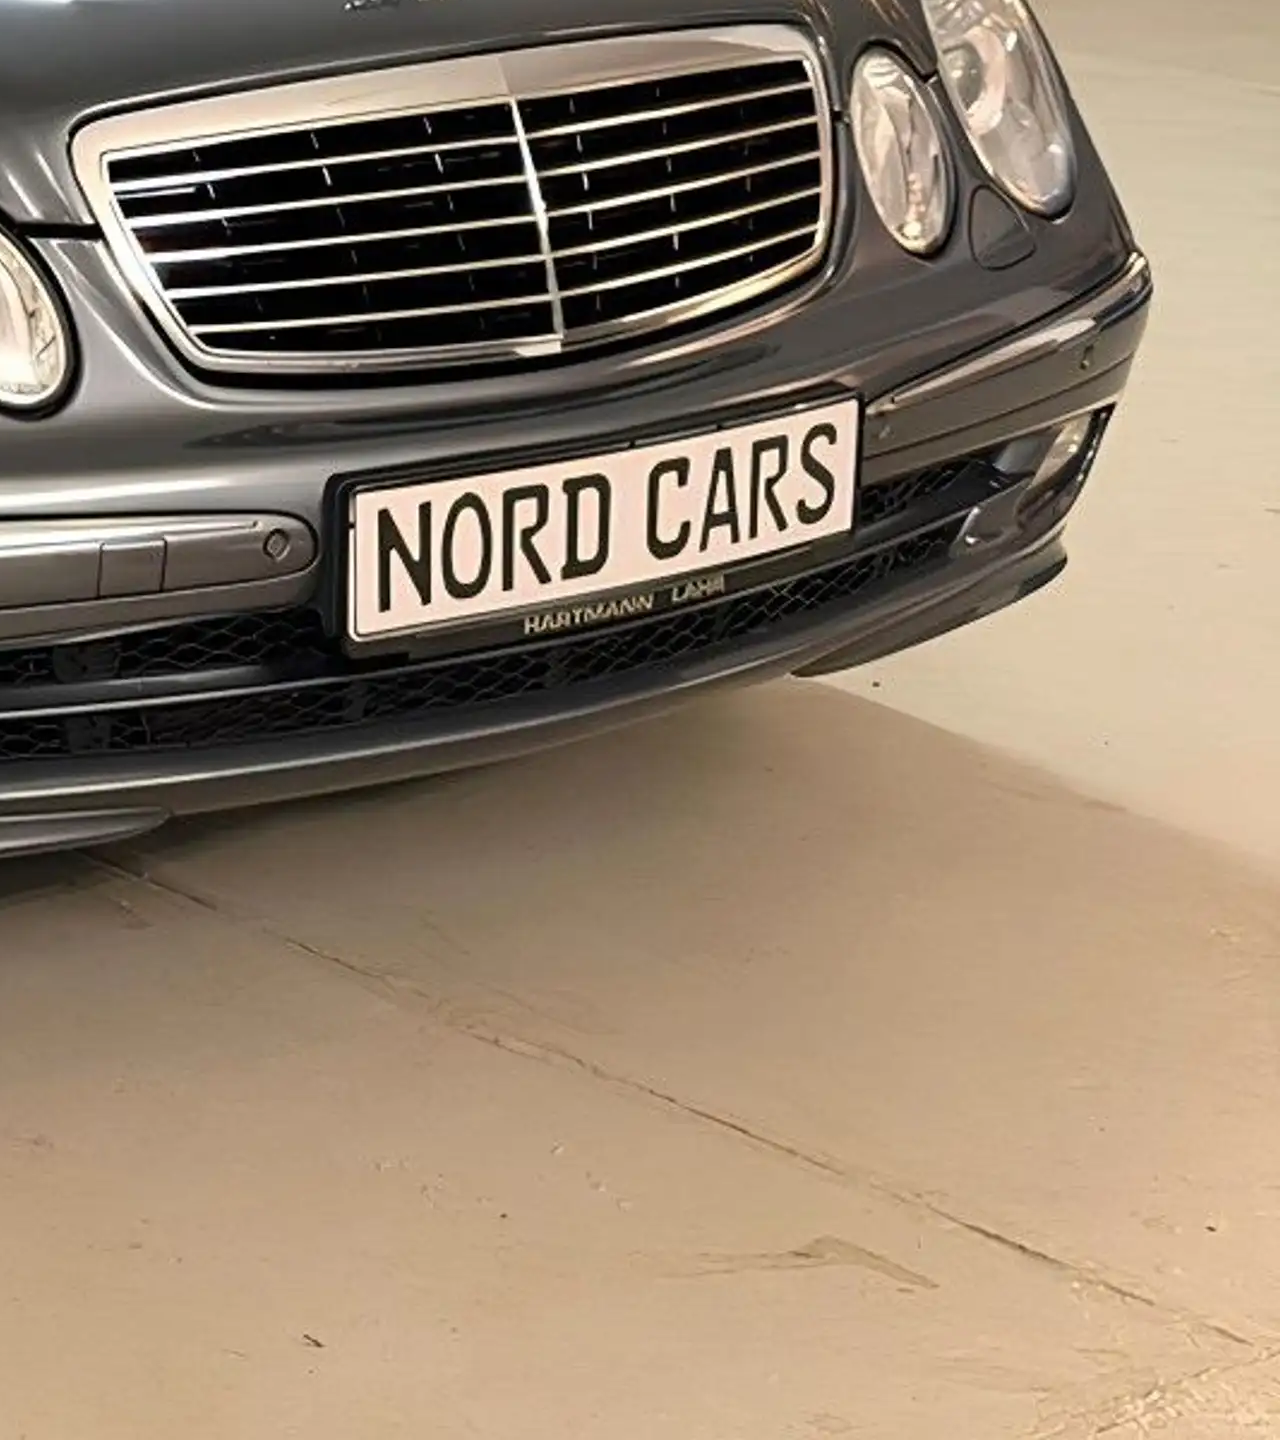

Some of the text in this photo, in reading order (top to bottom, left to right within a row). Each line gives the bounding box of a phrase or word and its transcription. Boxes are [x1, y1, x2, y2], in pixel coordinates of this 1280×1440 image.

[377, 422, 837, 613] NORD CARS
[523, 593, 656, 635] HARTMANN
